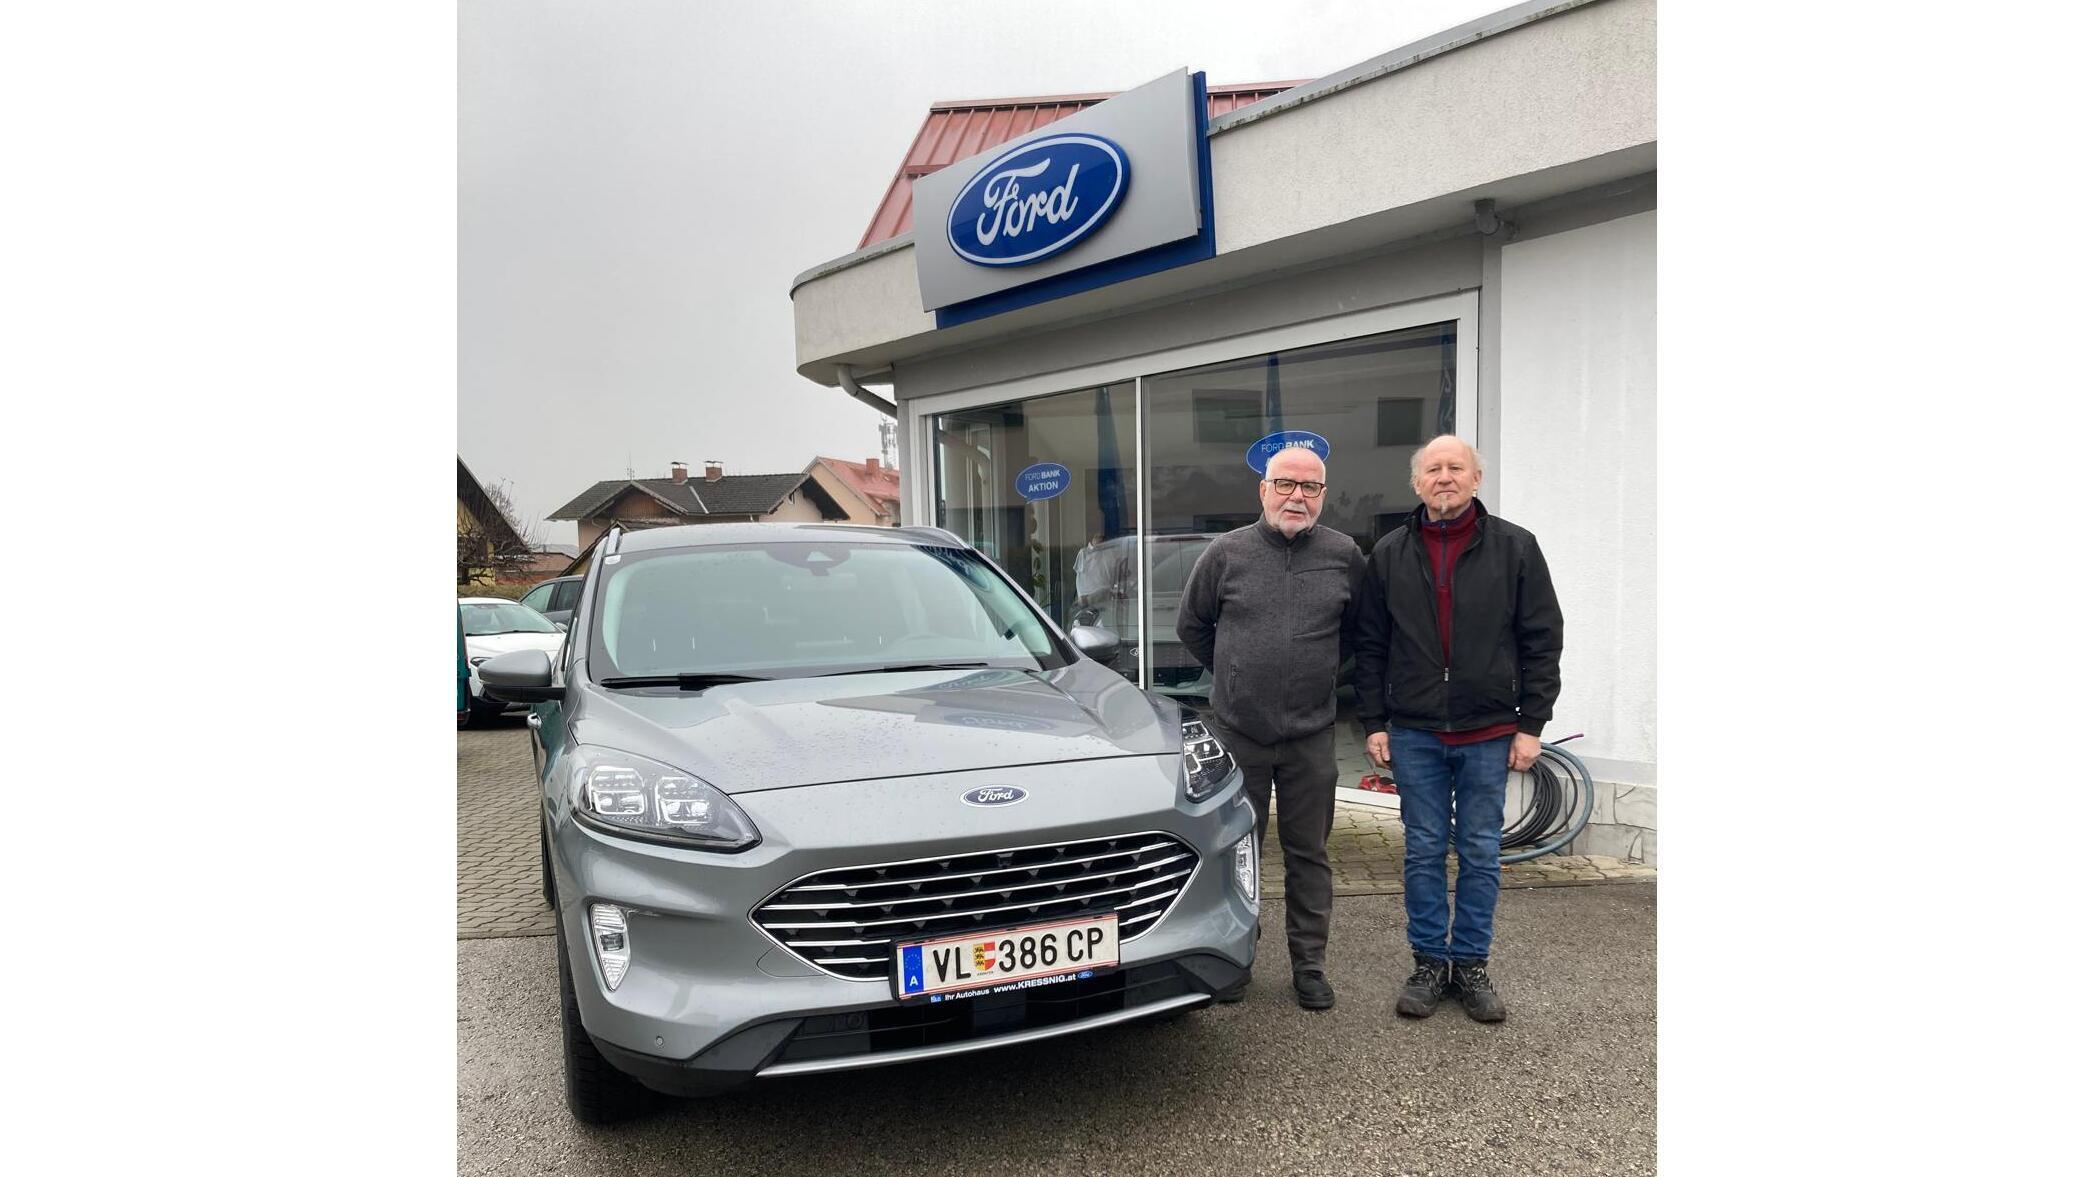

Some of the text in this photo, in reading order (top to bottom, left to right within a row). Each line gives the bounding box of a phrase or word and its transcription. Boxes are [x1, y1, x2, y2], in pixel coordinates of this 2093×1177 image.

[976, 157, 1080, 247] Ford
[1024, 469, 1061, 481] FORD BANK
[1028, 480, 1059, 493] AKTION
[977, 787, 1015, 802] Ford
[932, 927, 1104, 983] VL 386 CP
[909, 975, 919, 987] A
[944, 993, 955, 1001] Ihr
[955, 988, 990, 999] Autohaus
[993, 973, 1077, 993] www.KRESSNIG.at
